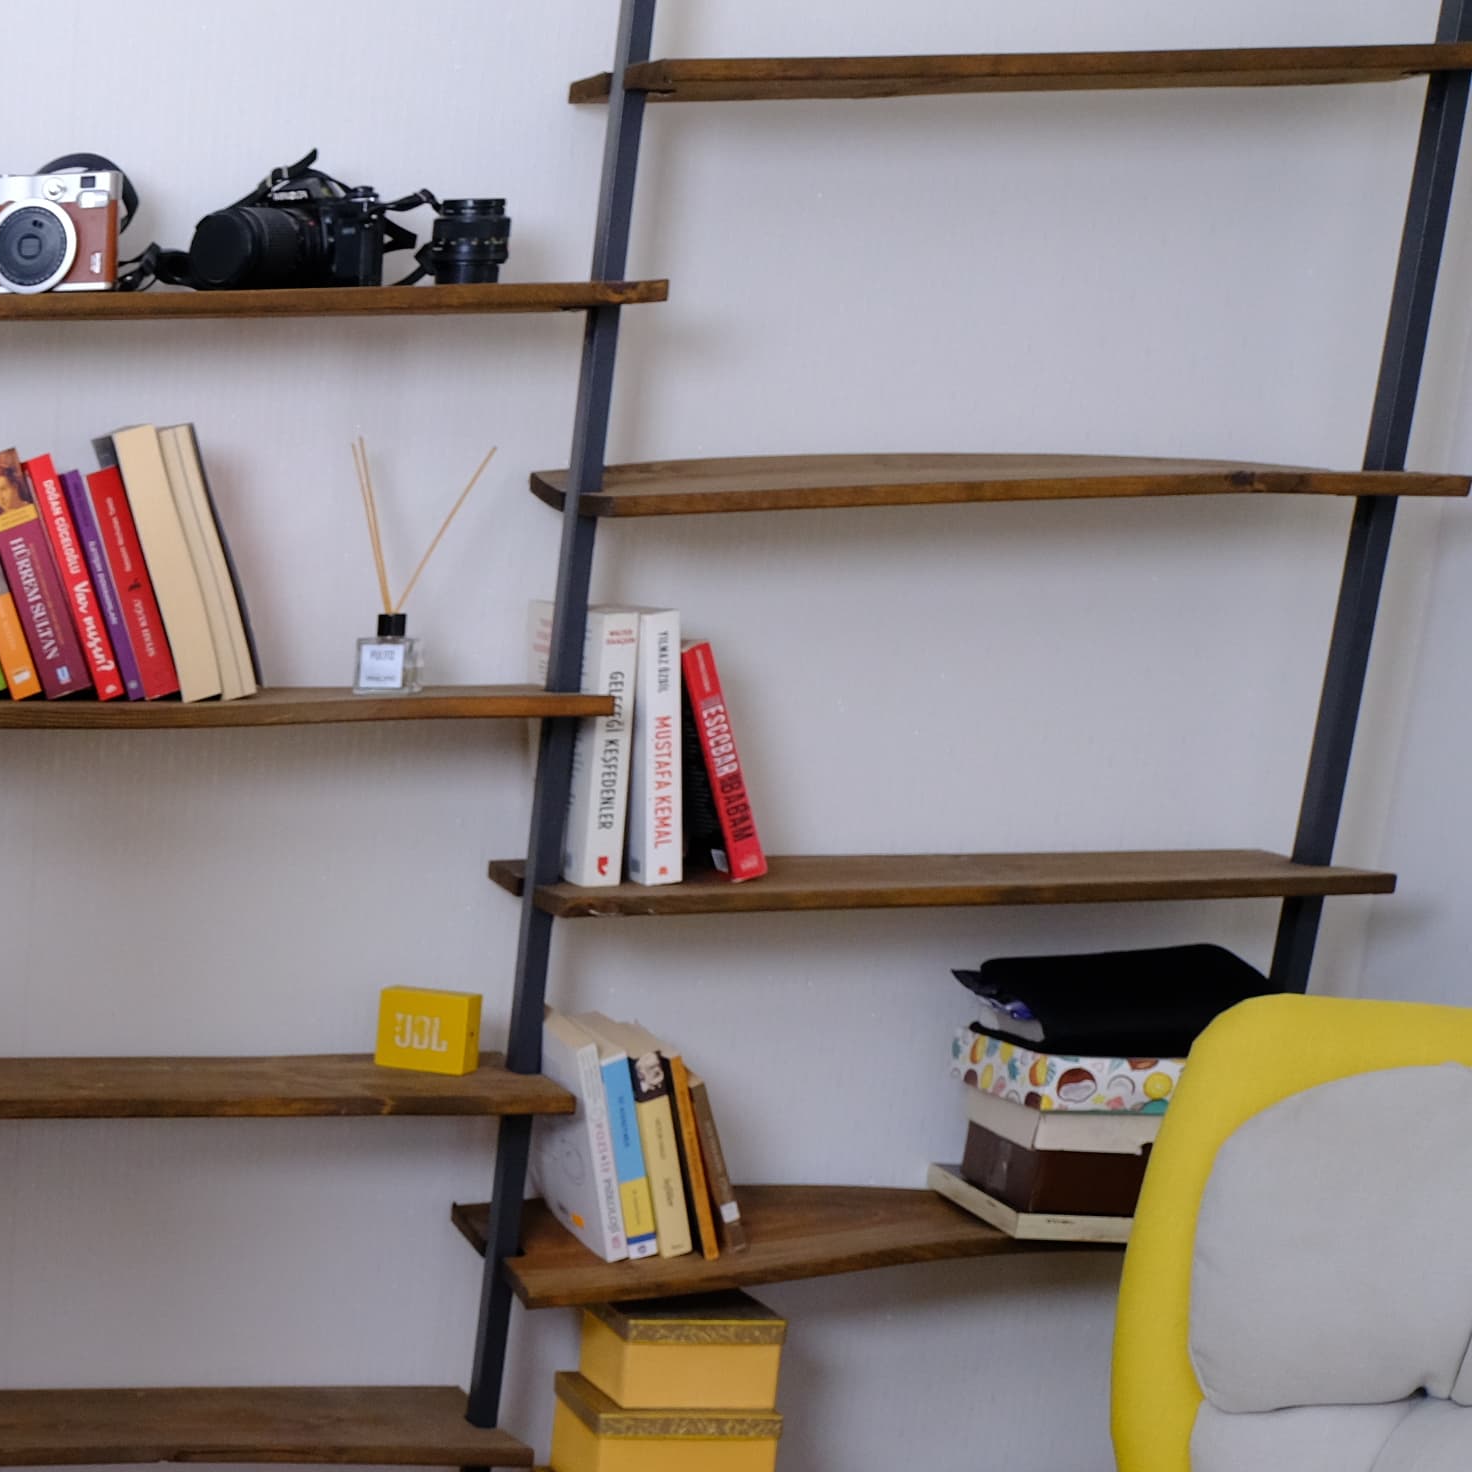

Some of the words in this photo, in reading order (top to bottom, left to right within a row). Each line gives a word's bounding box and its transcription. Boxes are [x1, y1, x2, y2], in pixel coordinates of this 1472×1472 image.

[42, 478, 64, 516] DOĞAN
[53, 515, 83, 575] CÜCELOĞLU
[8, 535, 45, 603] HÜRREM
[29, 602, 60, 660] SULTAN
[72, 580, 95, 613] Var
[657, 630, 668, 664] YILMAZ
[596, 738, 619, 830] KEŞFEDENLER
[654, 715, 671, 790] MUSTAFA
[655, 795, 671, 849] KEMAL
[720, 778, 753, 843] BABAM
[394, 1012, 448, 1052] JBL
